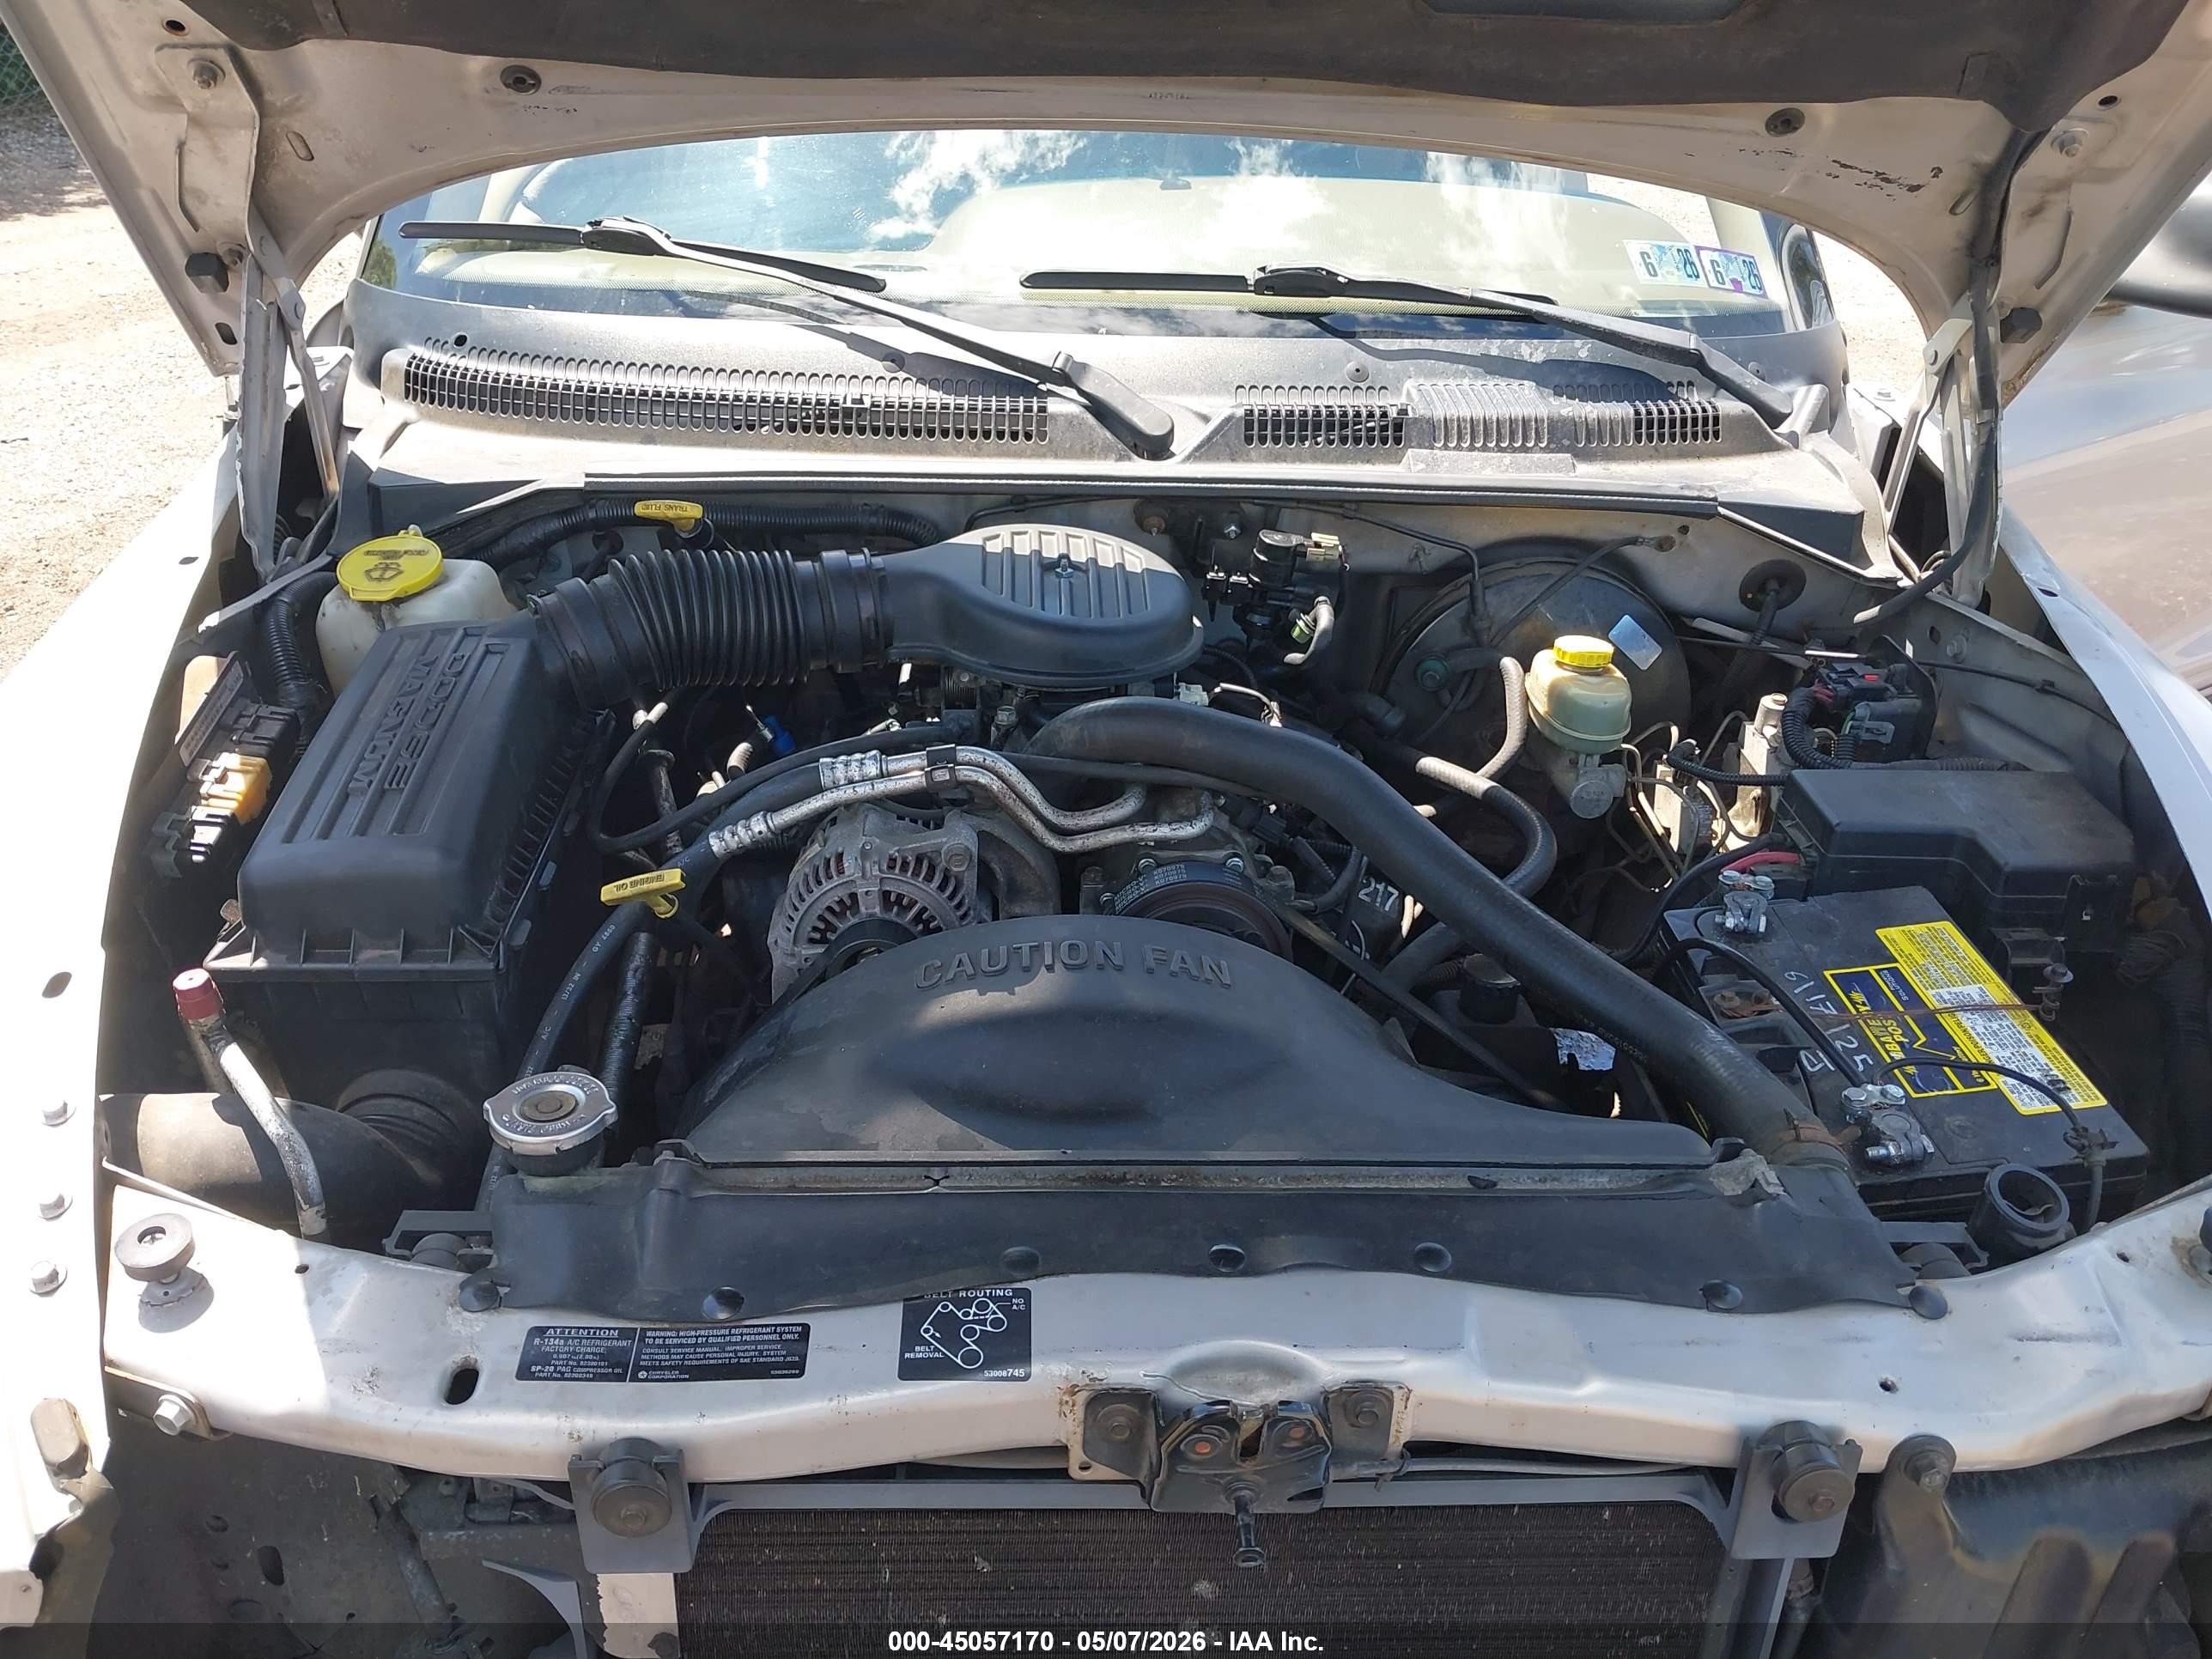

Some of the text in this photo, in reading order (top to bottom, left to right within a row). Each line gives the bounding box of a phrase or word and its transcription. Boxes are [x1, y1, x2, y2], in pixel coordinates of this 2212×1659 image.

[1639, 252, 1658, 277] 6
[1676, 248, 1700, 279] 26
[1710, 259, 1726, 285] 6
[1742, 258, 1763, 291] 26
[664, 504, 688, 513] TRANS
[613, 874, 665, 892] ENGINE OIL
[914, 939, 1231, 990] CAUTION FAN
[958, 1289, 1013, 1298] ROUTING
[545, 1328, 619, 1336] ATTENTION
[678, 1328, 730, 1337] HIGH-PRESSURE
[731, 1326, 775, 1334] REFRIGERANT
[983, 1369, 1025, 1377] 53008745
